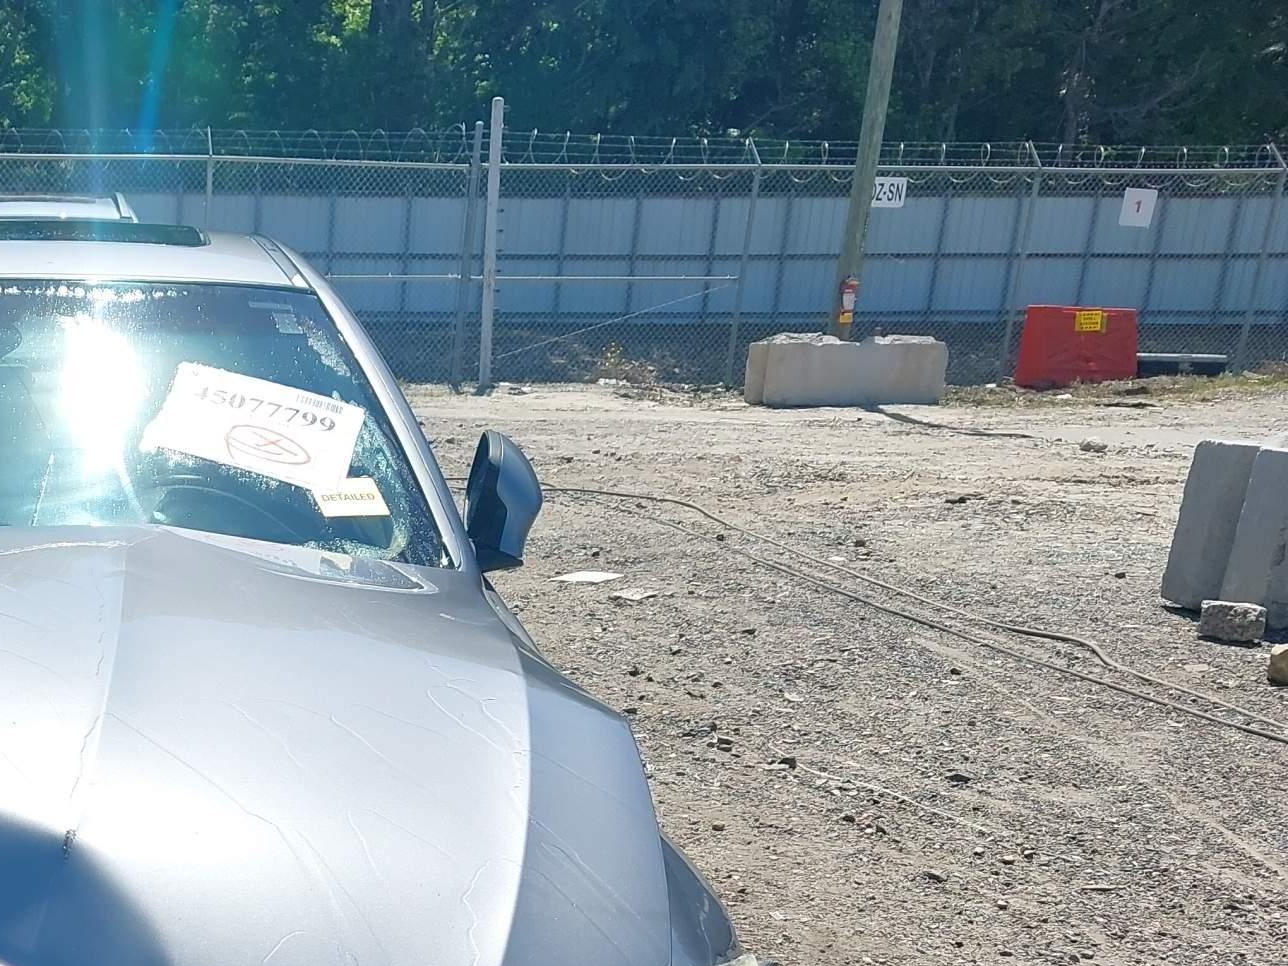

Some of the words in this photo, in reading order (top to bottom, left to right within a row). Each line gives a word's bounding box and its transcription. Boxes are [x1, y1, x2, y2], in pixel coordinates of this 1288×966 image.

[1136, 200, 1142, 213] 1
[193, 386, 336, 432] 45077799
[321, 492, 376, 502] DETAILED
